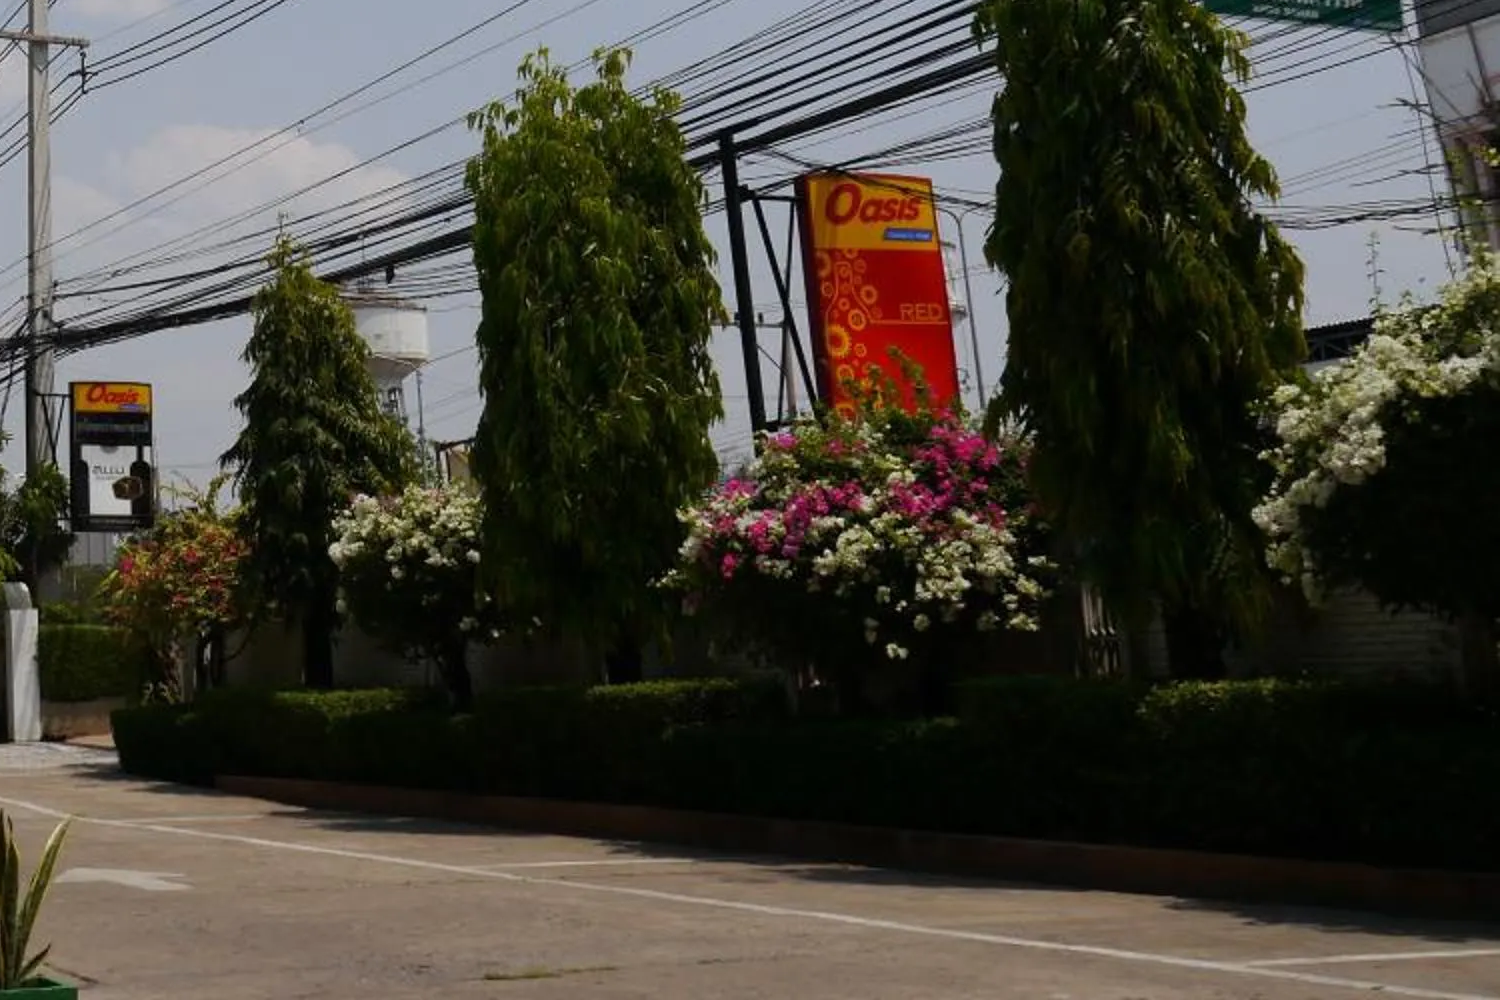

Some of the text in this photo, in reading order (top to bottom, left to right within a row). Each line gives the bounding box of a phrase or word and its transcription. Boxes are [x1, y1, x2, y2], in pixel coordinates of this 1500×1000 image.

[825, 183, 923, 226] Oasis
[900, 303, 943, 322] RED
[87, 382, 140, 404] Oasis
